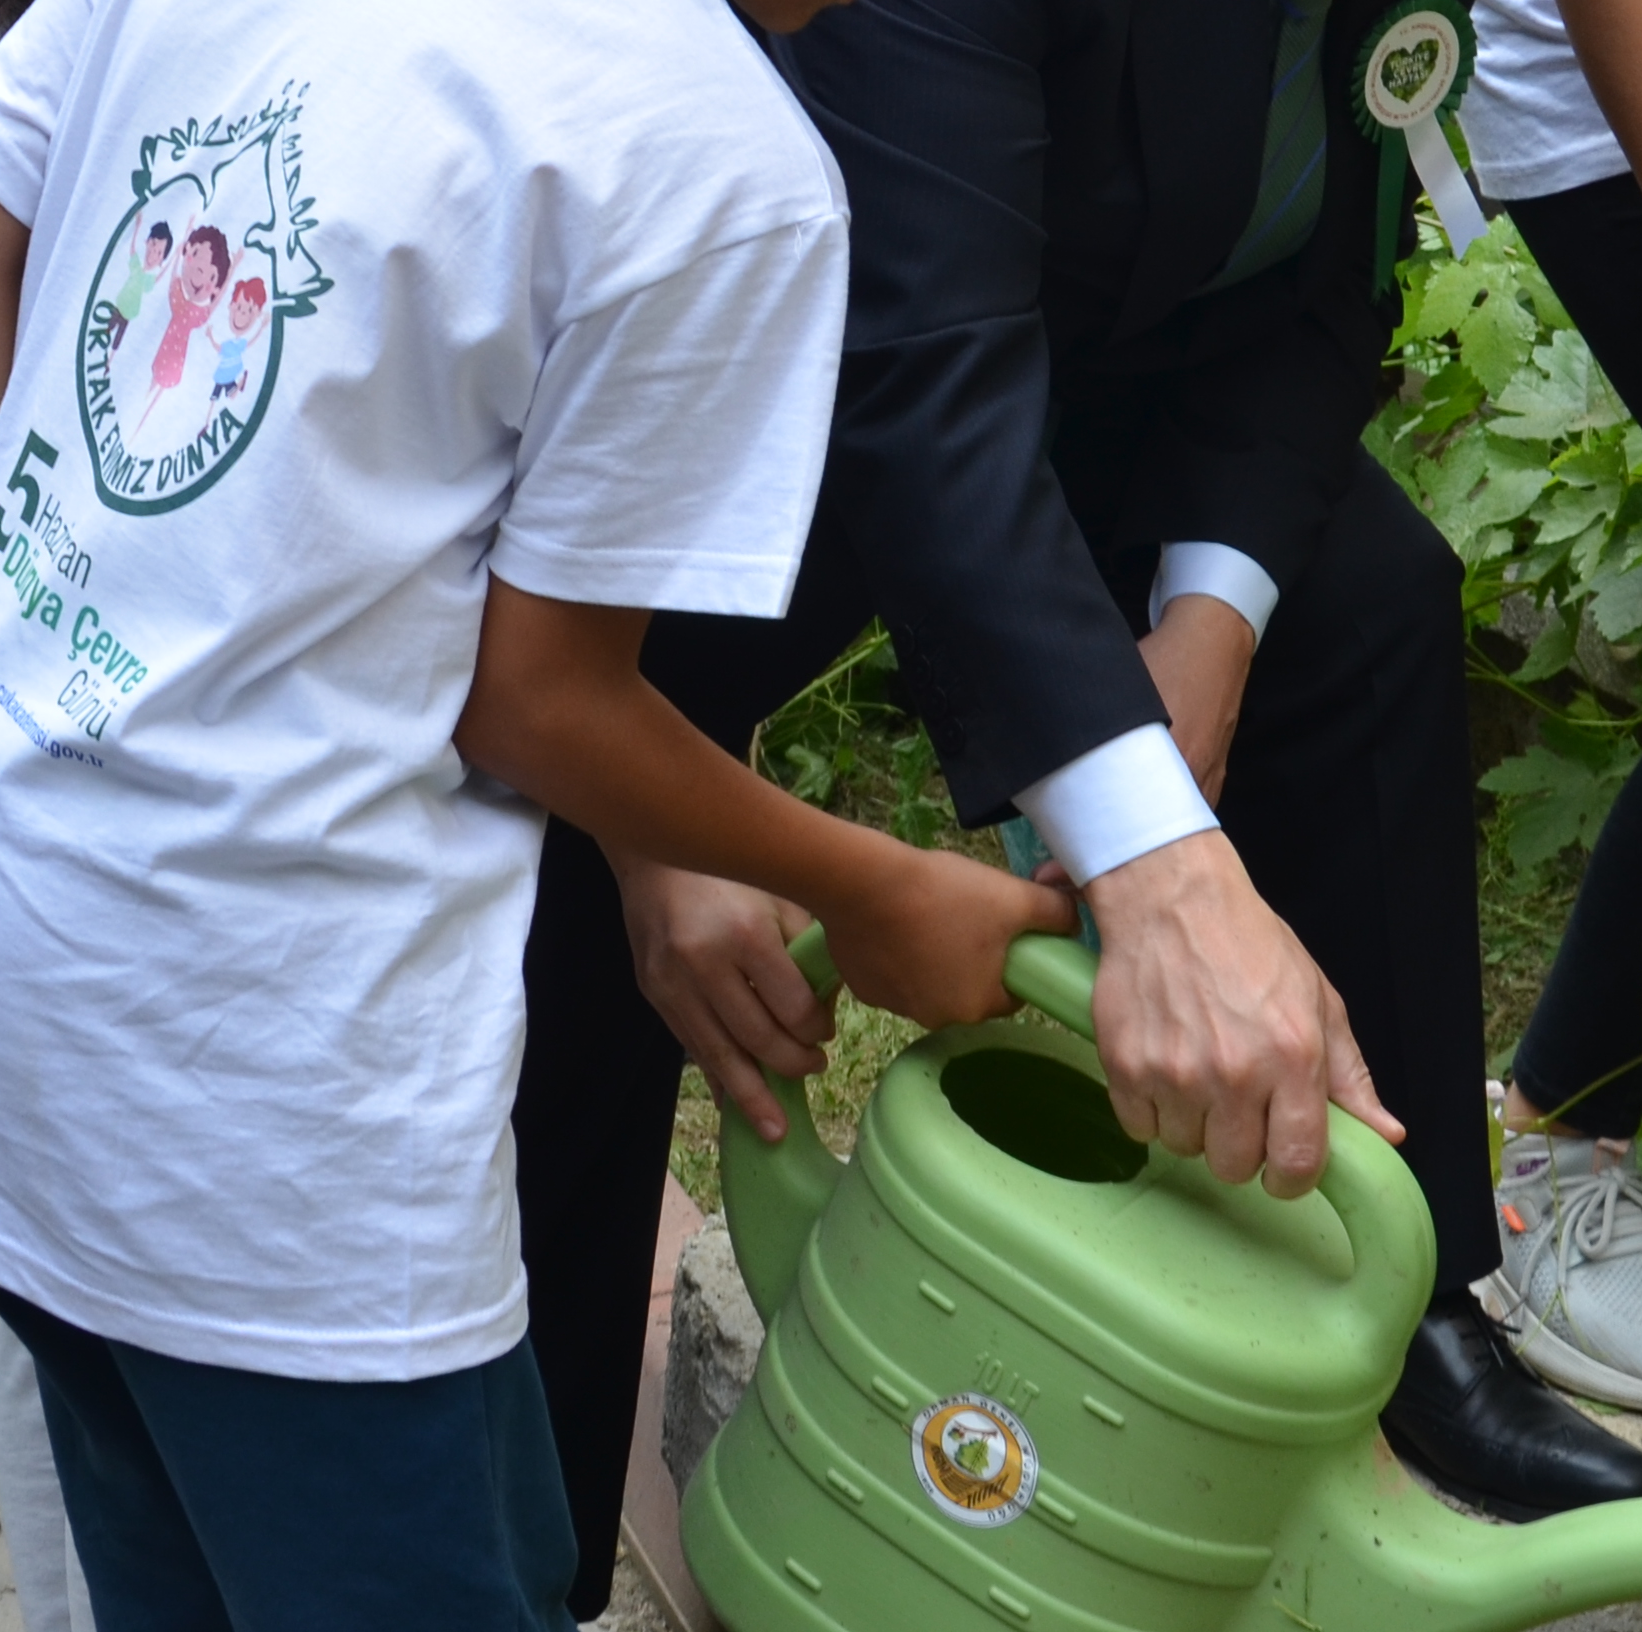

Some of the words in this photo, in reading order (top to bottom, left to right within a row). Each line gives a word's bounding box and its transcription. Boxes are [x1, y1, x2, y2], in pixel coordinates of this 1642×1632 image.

[87, 300, 116, 430] ORTAK
[156, 407, 245, 492] DÜNYA
[34, 493, 93, 590] Haziran
[2, 533, 64, 632] Dünya
[67, 605, 149, 695] Çevre
[56, 669, 118, 742] Günü
[922, 1394, 971, 1419] ORMAN
